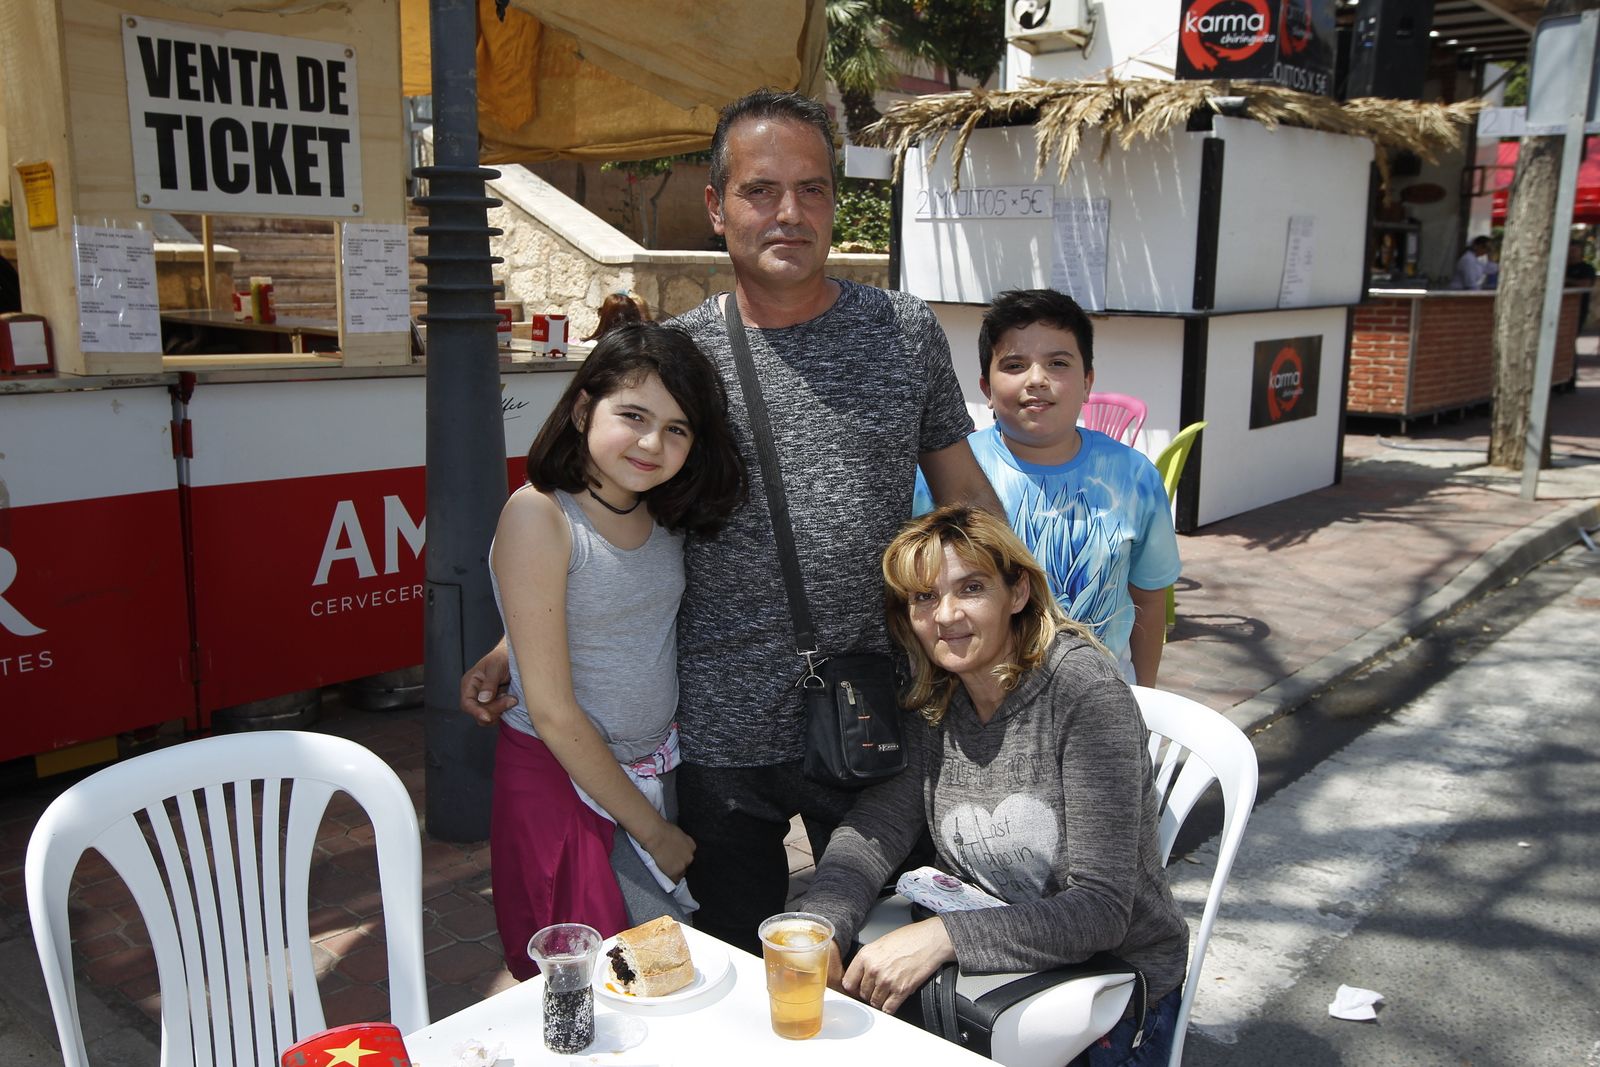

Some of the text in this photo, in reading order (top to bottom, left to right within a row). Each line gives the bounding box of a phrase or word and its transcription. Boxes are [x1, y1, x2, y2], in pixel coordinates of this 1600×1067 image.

[1185, 12, 1265, 33] karma
[137, 35, 349, 116] VENTA DE
[144, 111, 351, 198] TICKET
[916, 190, 930, 215] 2
[933, 189, 1008, 216] MOJITOS
[1020, 189, 1044, 215] 5€
[1269, 371, 1301, 389] karma
[311, 584, 424, 616] CERVECER
[1012, 844, 1035, 863] in
